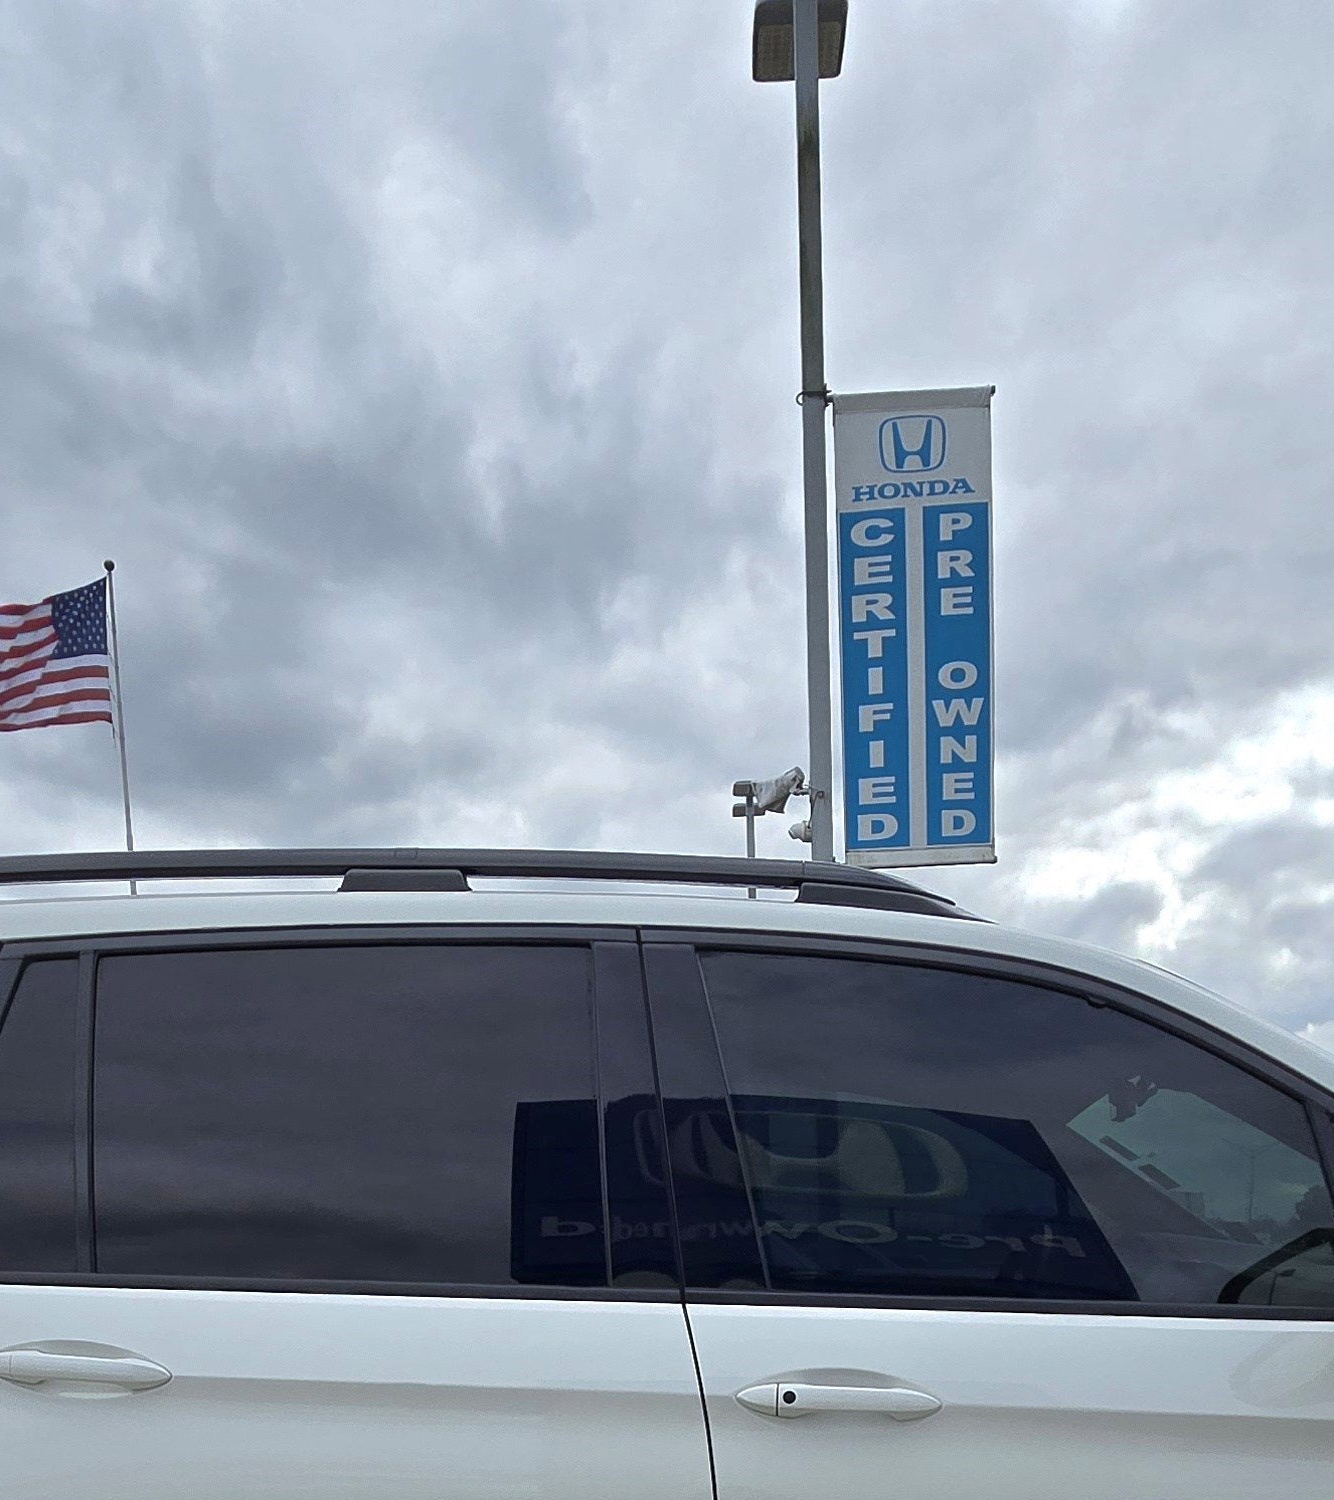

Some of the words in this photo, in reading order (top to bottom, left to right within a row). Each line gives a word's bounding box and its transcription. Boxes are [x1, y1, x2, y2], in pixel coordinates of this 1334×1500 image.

[851, 477, 976, 503] HONDA
[936, 511, 975, 617] PRE
[849, 516, 899, 842] CERTIFIED
[931, 660, 985, 838] OWNED
